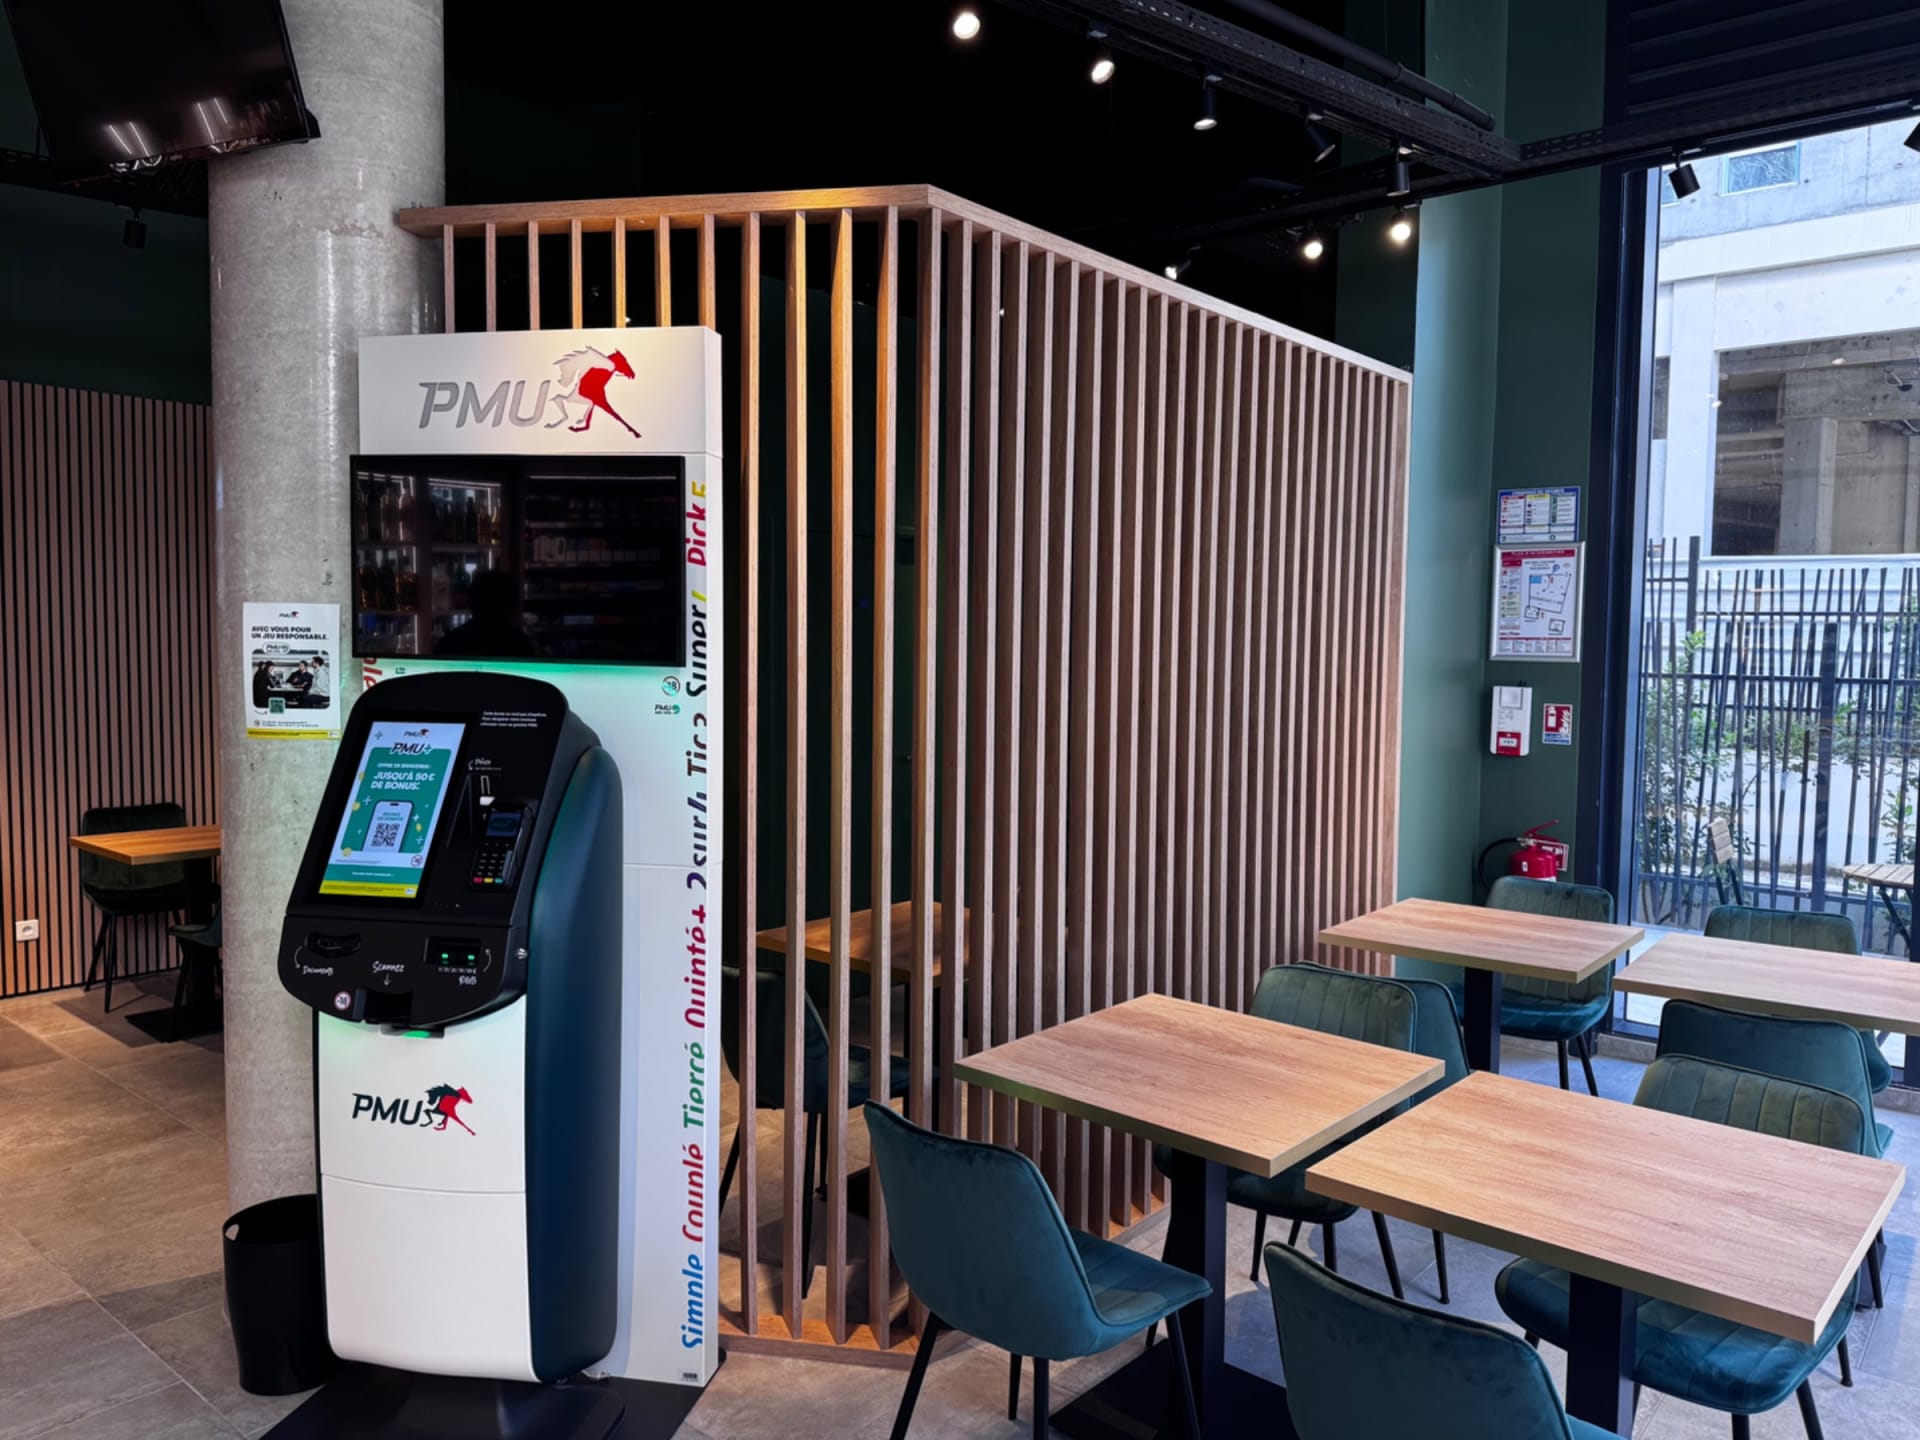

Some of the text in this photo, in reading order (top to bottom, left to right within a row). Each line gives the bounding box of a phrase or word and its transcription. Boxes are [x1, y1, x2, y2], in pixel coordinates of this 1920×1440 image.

[419, 380, 551, 429] PMU
[371, 781, 384, 789] DE
[352, 1093, 423, 1125] PMU
